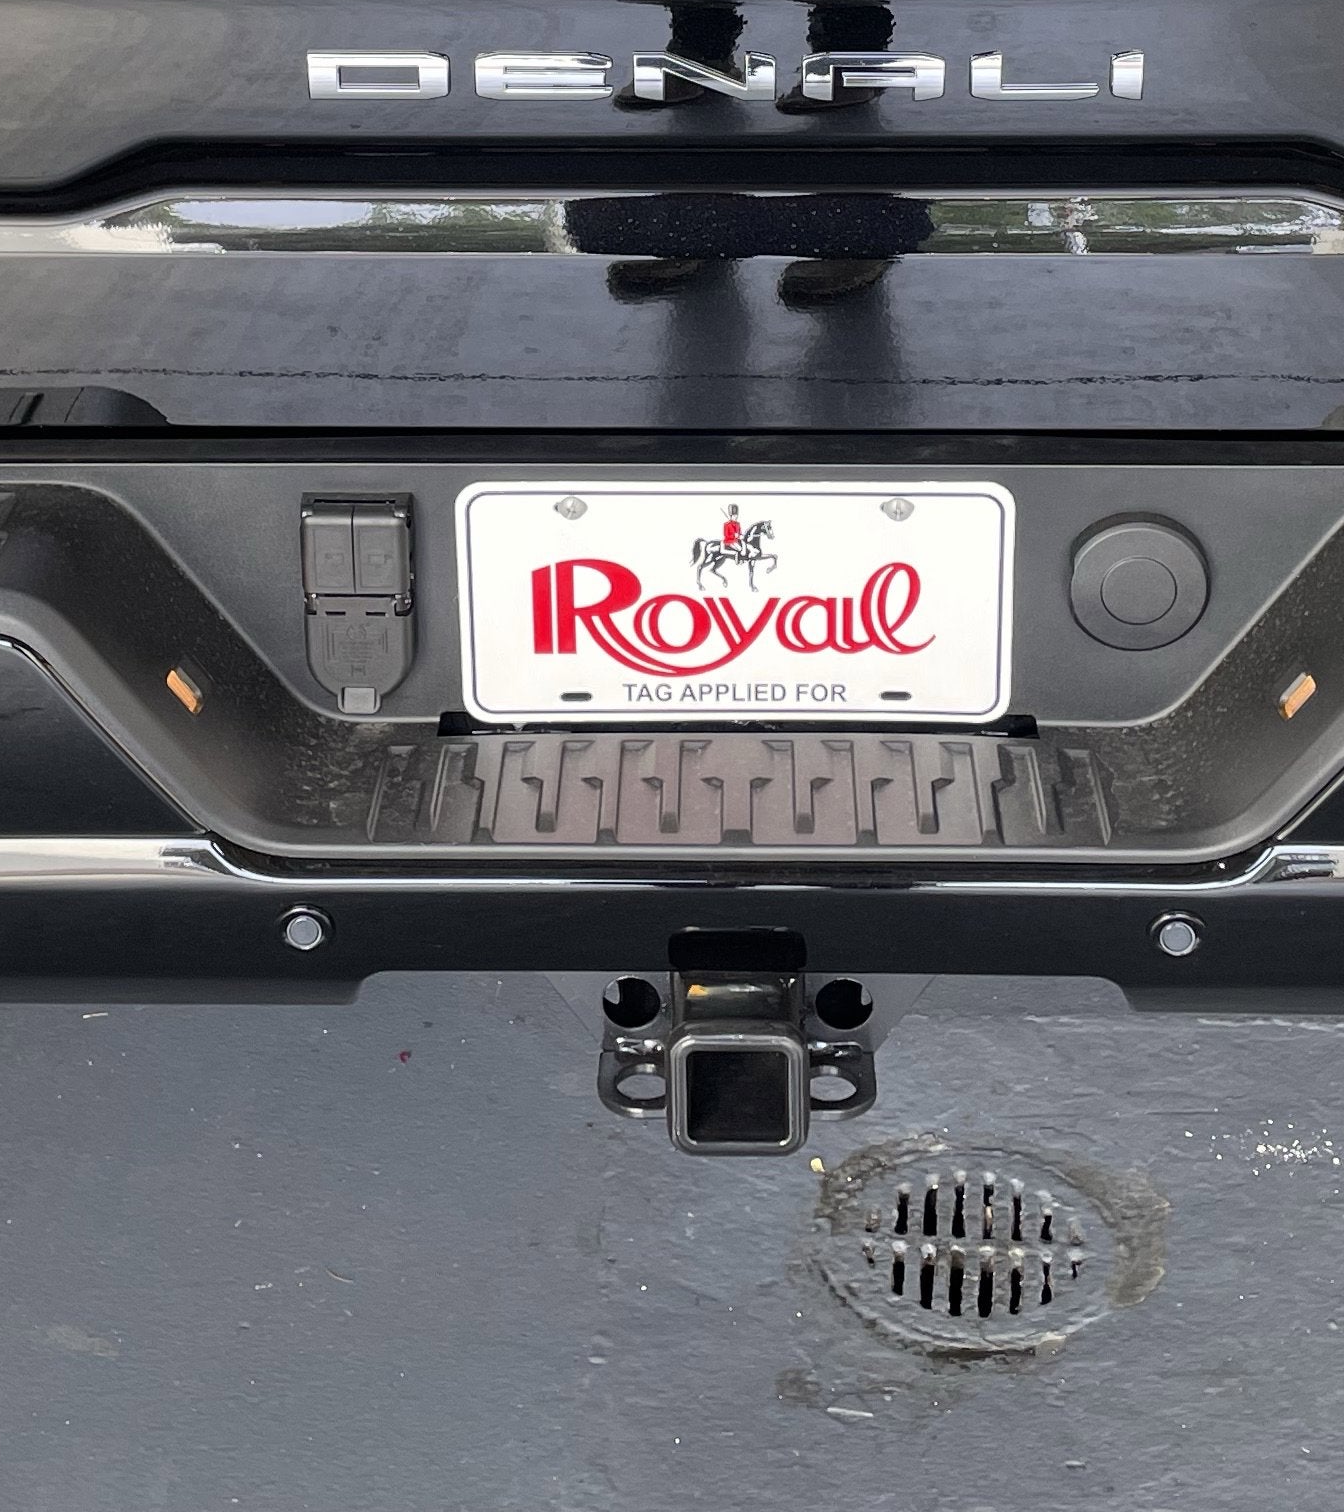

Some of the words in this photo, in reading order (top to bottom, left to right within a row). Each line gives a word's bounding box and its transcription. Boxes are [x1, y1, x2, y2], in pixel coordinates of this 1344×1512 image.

[306, 49, 1146, 101] DENALI
[531, 558, 937, 678] Royal
[622, 682, 674, 702] TAG
[679, 682, 787, 702] APPLIED
[795, 682, 848, 702] FOR
